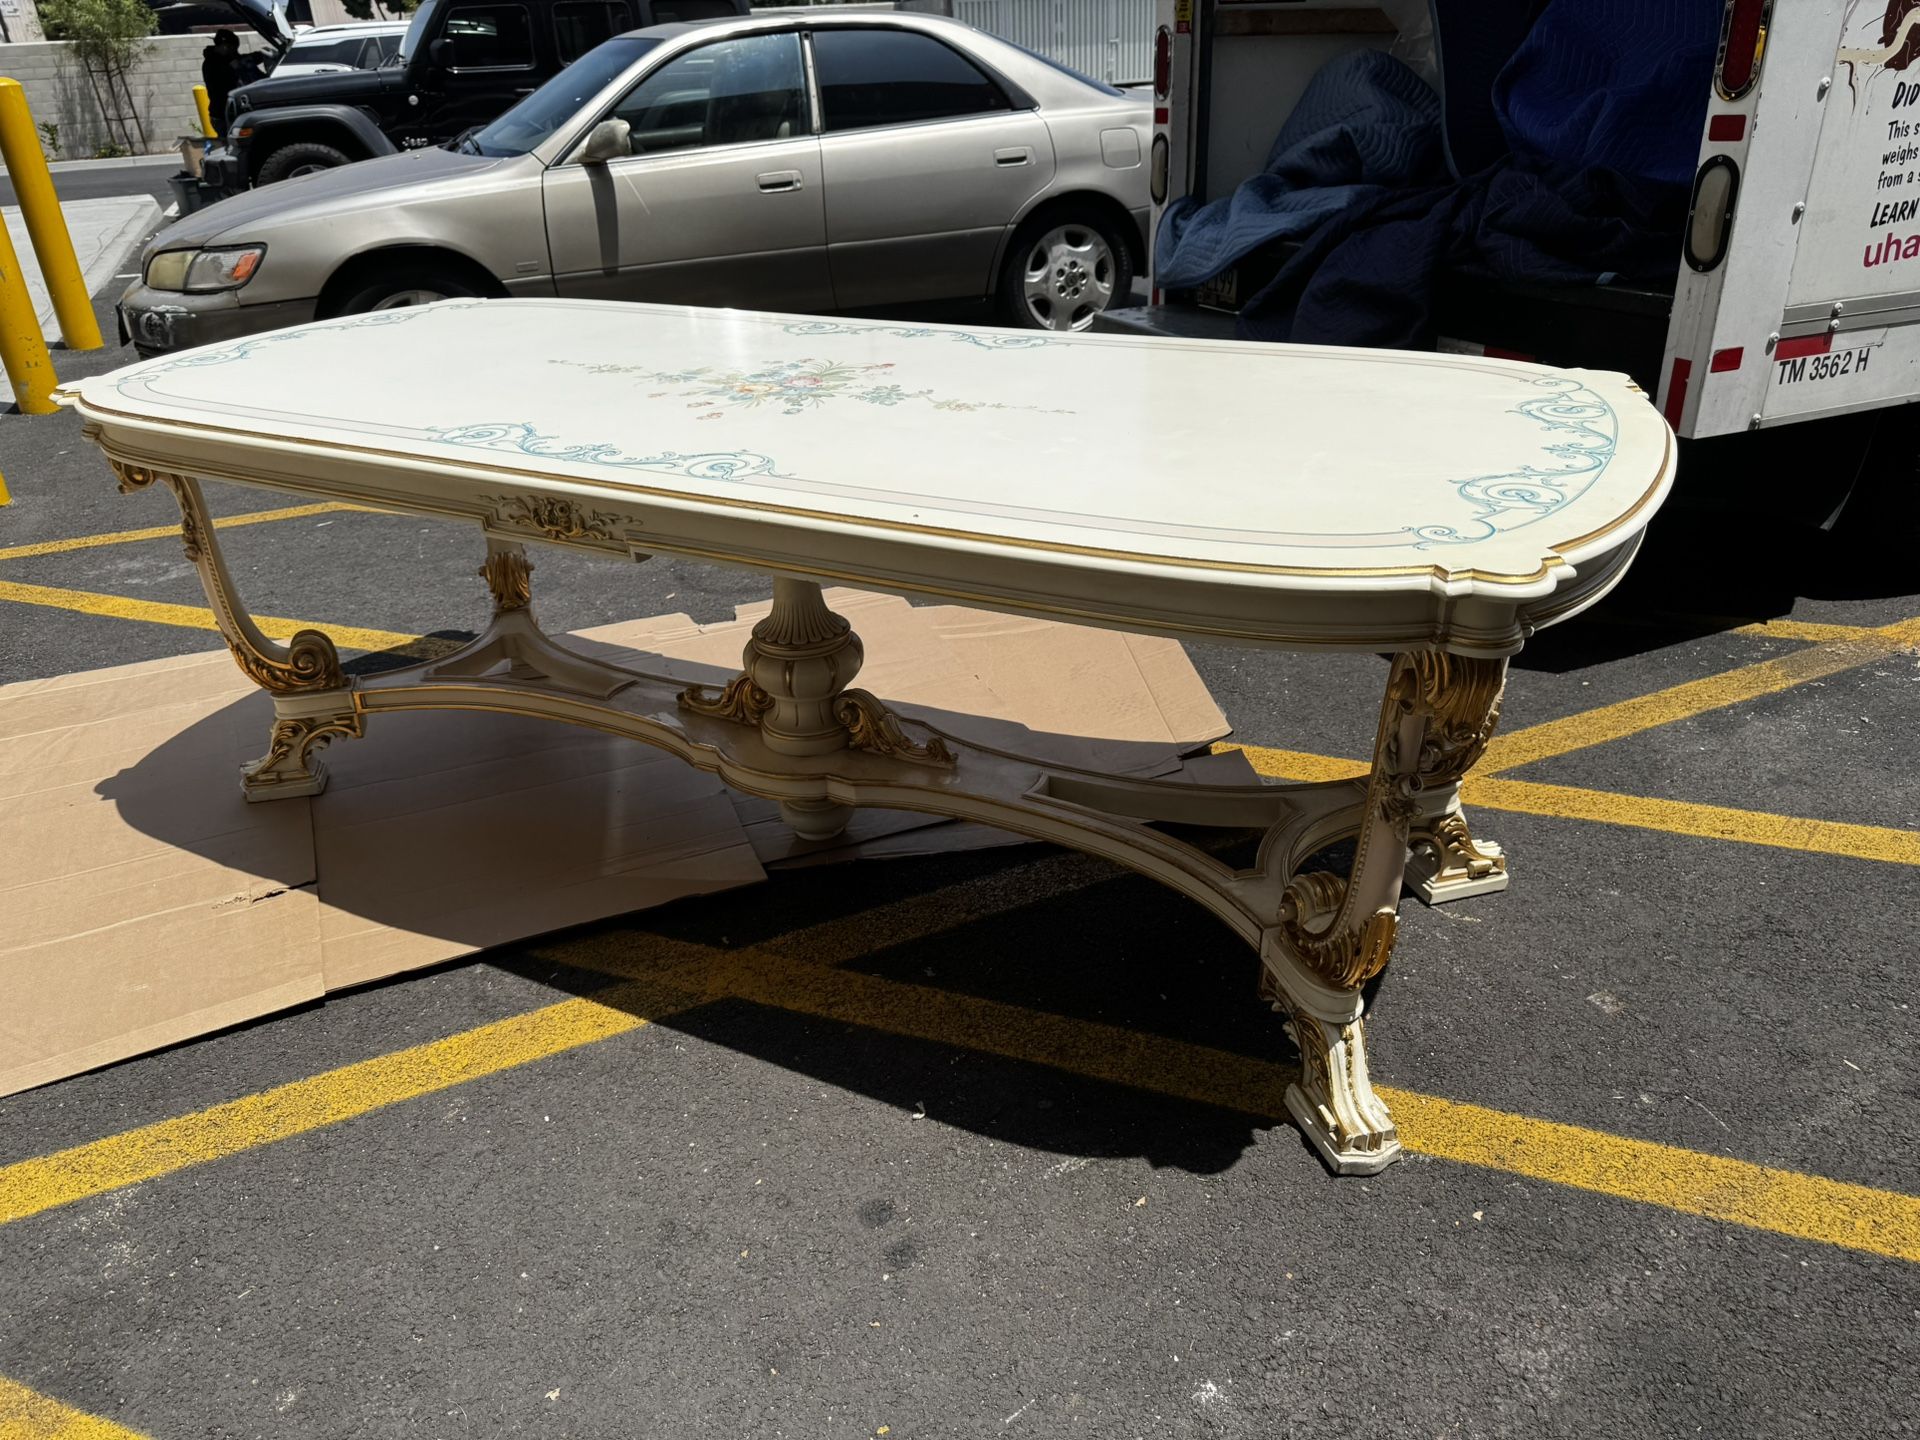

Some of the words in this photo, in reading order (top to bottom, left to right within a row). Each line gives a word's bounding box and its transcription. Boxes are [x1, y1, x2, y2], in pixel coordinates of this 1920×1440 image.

[1888, 120, 1910, 141] This
[1882, 142, 1919, 165] weighs
[1877, 171, 1904, 190] from
[1907, 171, 1914, 183] a
[1870, 198, 1920, 228] LEARN
[1863, 232, 1920, 268] uha
[1779, 357, 1807, 385] TM
[1809, 351, 1852, 381] 3562
[1855, 348, 1870, 374] H
